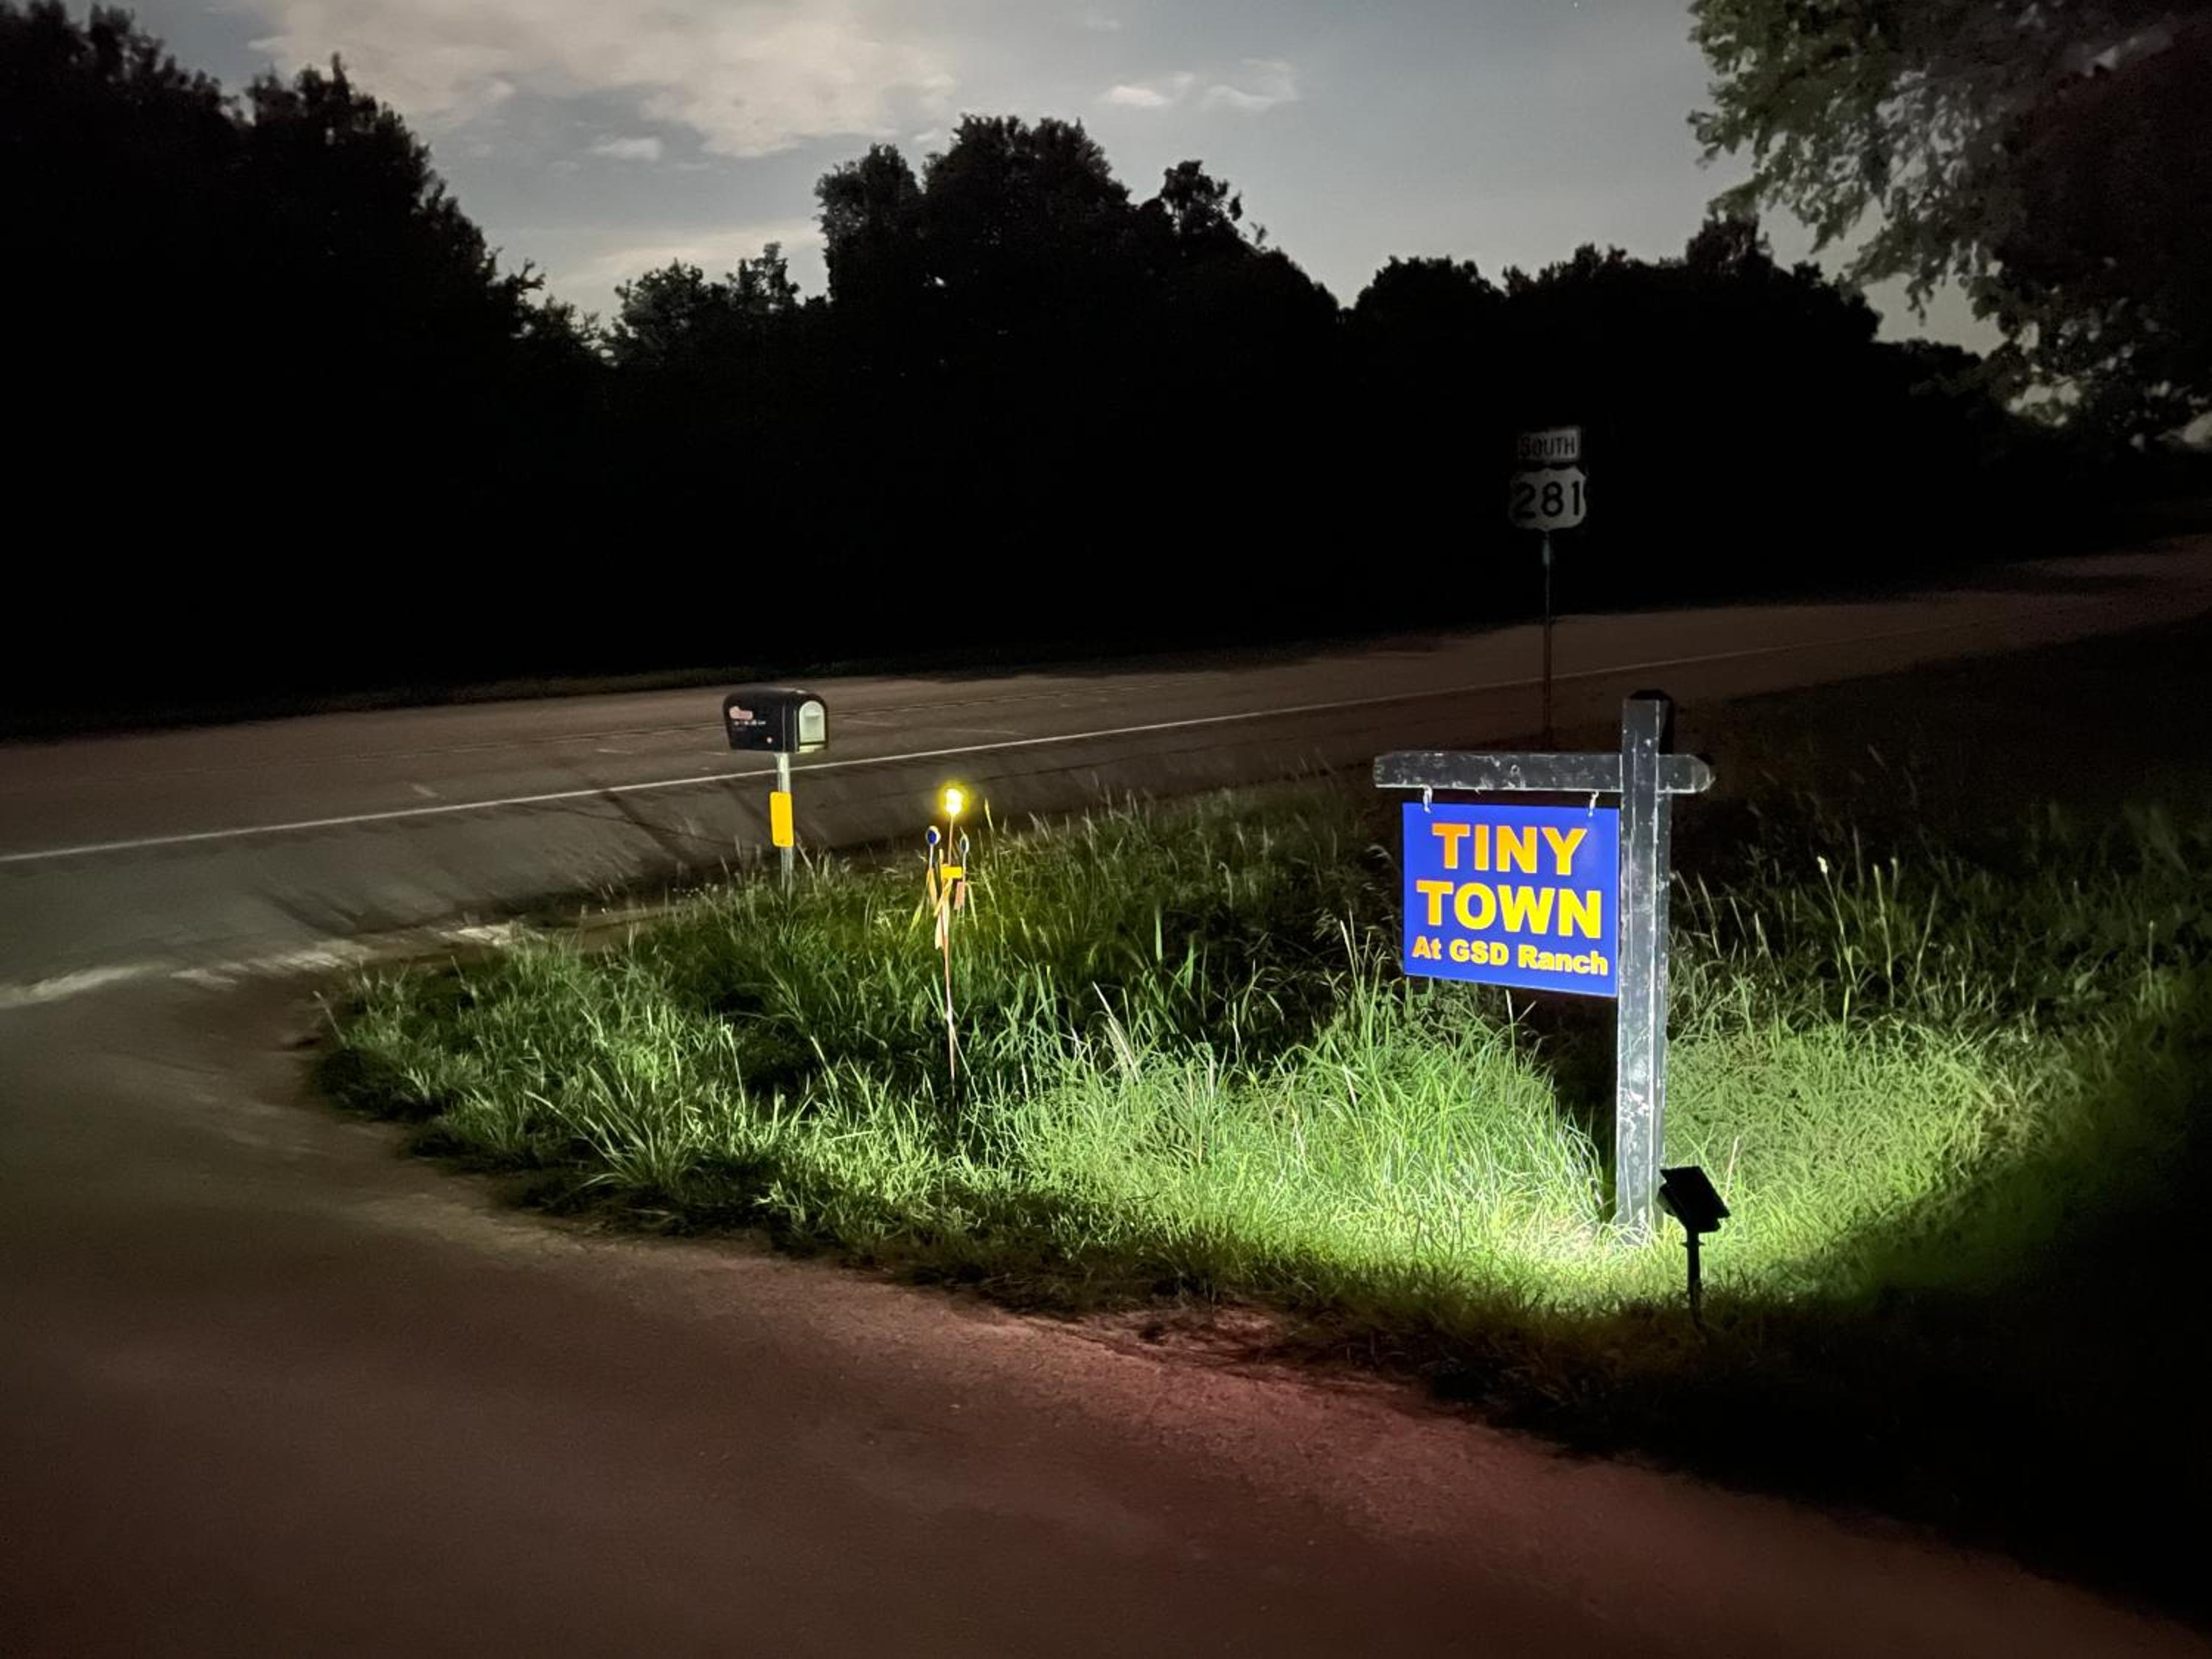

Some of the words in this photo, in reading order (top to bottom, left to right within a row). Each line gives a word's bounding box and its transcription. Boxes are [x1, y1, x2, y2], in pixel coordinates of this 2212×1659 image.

[1520, 436, 1576, 456] SOUTH
[1514, 481, 1579, 518] 281
[1432, 822, 1587, 874] TINY
[1416, 880, 1601, 939] TOWN
[1412, 936, 1441, 959] At
[1449, 939, 1509, 966] GSD
[1517, 945, 1608, 976] Ranch
